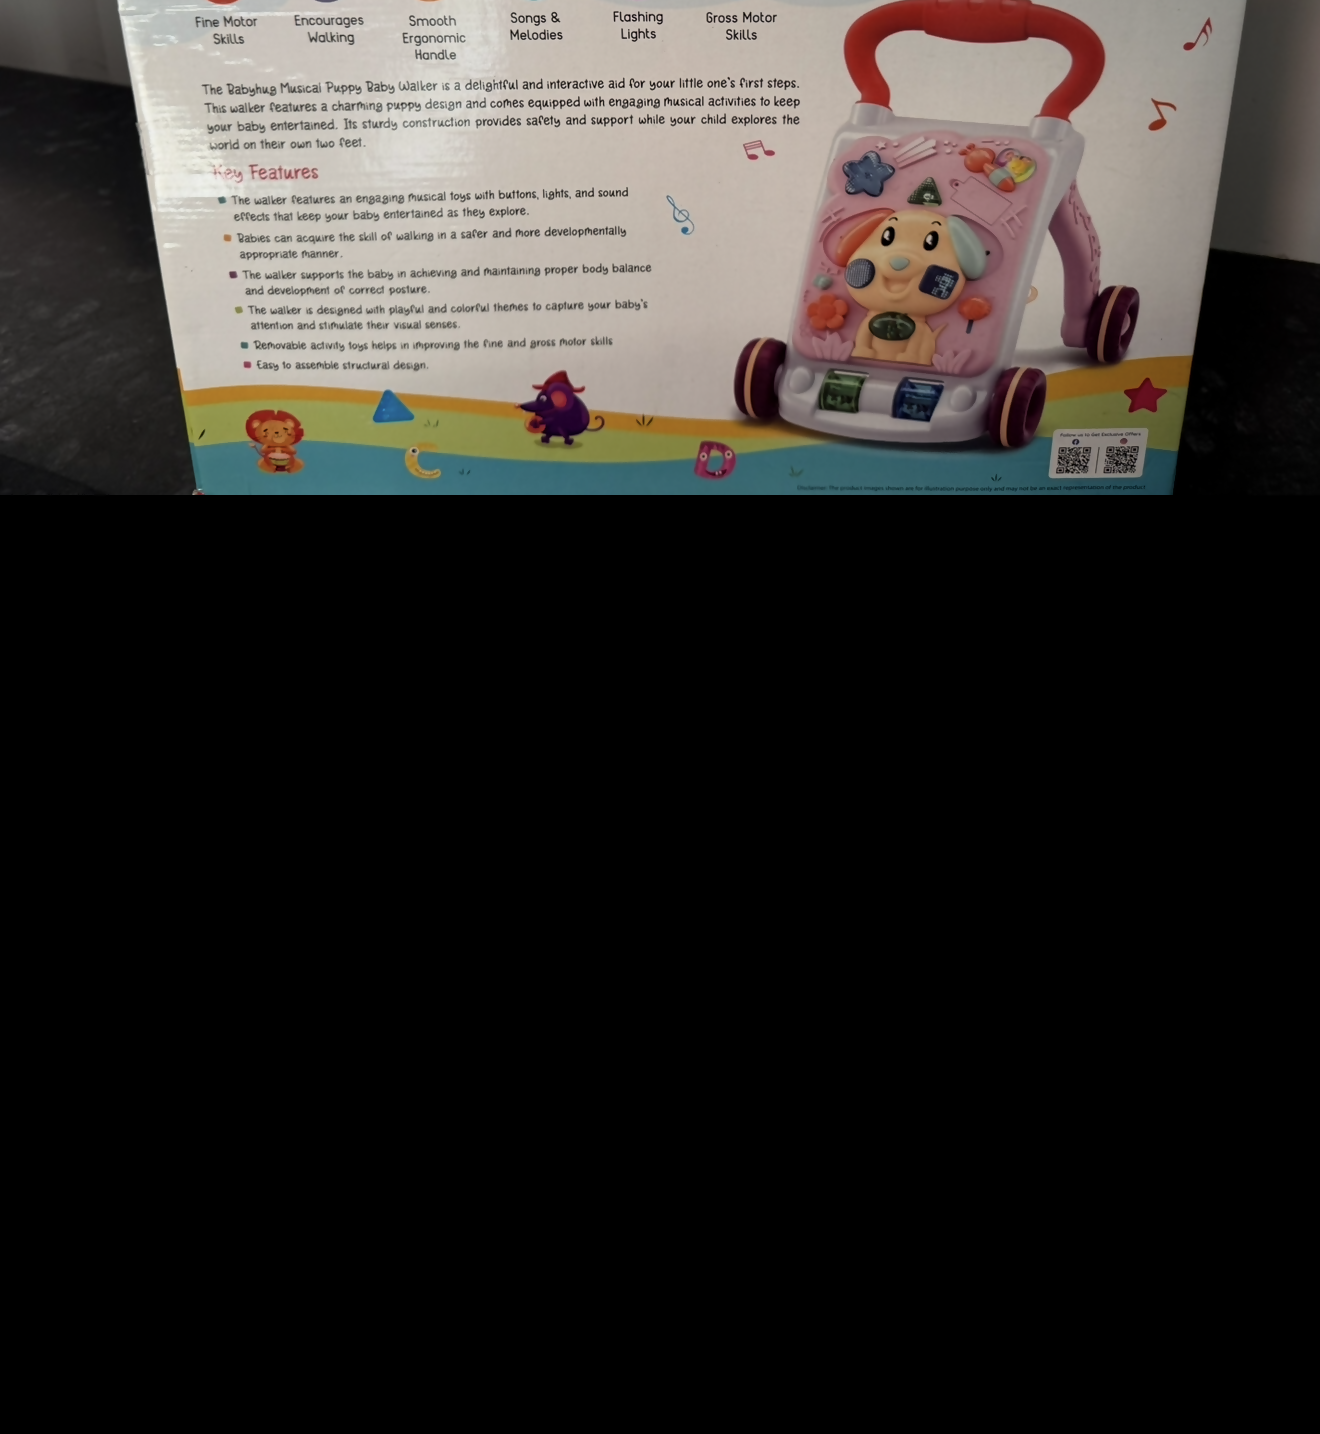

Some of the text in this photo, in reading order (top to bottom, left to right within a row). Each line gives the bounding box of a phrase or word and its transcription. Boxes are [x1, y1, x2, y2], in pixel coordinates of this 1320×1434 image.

[194, 15, 258, 28] Fine Motor
[293, 13, 364, 29] Encourages
[408, 14, 457, 26] Smooth
[509, 11, 561, 26] Songs &
[612, 10, 664, 25] Flashing
[705, 11, 778, 23] Gross Motor
[212, 32, 245, 45] Skills
[306, 31, 355, 45] Walking
[401, 31, 466, 46] Ergonomic
[509, 28, 563, 40] Melodies
[620, 27, 656, 42] Lights
[724, 28, 758, 40] Skills
[414, 48, 457, 60] Handle
[201, 76, 800, 97] The Babyhug Musical Puppy Baby Walker is a delightful and interactive aid for your little one's first steps.
[203, 95, 801, 113] This walker features a charming puppy design and comes equipped with engaging musical activities to keep
[206, 113, 800, 134] your baby entertained. Its sturdy construction provides safety and support while your child explores the
[208, 136, 366, 150] world on their own two feet.
[212, 163, 319, 183] Key Features
[230, 186, 629, 205] The walker features an engaging musical toys with buttons, lights, and sound
[233, 206, 530, 222] effects that keep your baby entertained as they explore.
[241, 269, 262, 280] The
[264, 270, 297, 280] walker
[300, 270, 344, 281] supports
[347, 269, 364, 279] the
[366, 268, 394, 281] baby
[409, 267, 458, 279] achieving
[460, 266, 480, 277] and
[482, 266, 541, 277] maintaining
[543, 265, 578, 276] proper
[581, 263, 609, 275] body
[611, 262, 652, 273] balance
[244, 284, 431, 296] and development of correct posture.
[246, 298, 648, 316] The walker is designed with playful and colorful themes to capture your baby's
[252, 339, 307, 350] Removable
[310, 340, 346, 352] activity
[347, 341, 368, 352] toys
[370, 340, 397, 351] helps
[412, 340, 460, 351] improving
[463, 339, 479, 349] the
[482, 338, 503, 348] fine
[506, 337, 526, 348] and
[529, 339, 556, 349] gross
[558, 337, 586, 346] motor
[590, 336, 613, 346] skills
